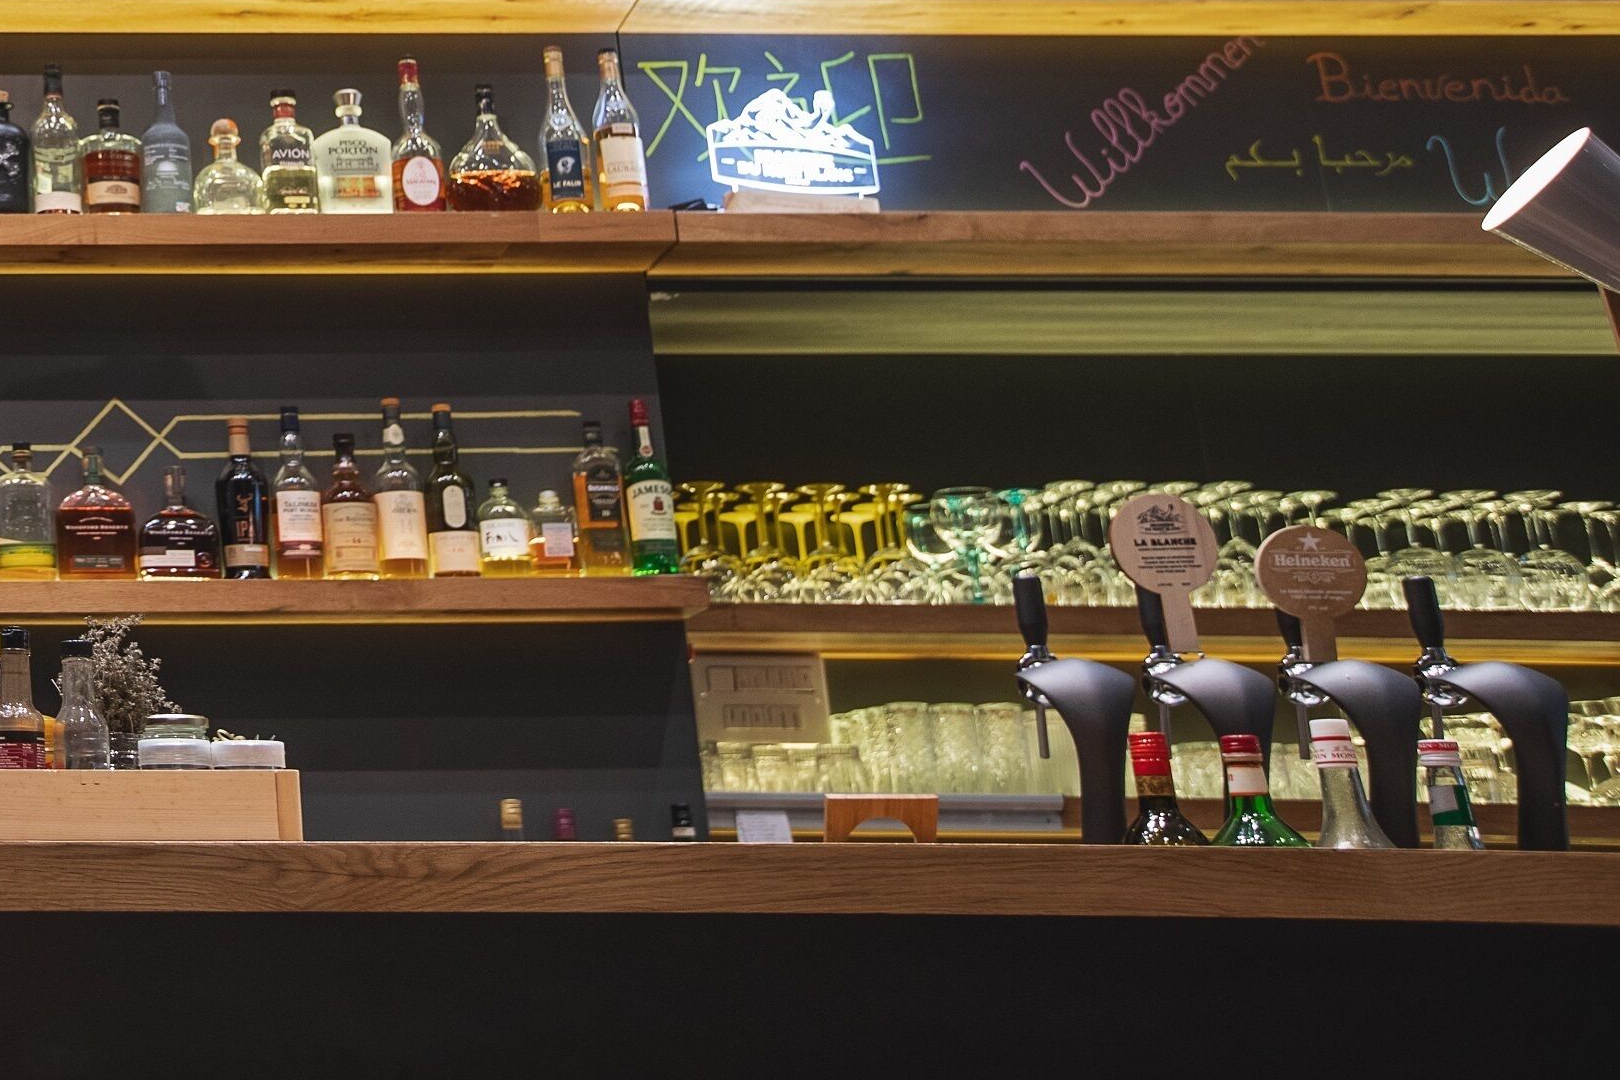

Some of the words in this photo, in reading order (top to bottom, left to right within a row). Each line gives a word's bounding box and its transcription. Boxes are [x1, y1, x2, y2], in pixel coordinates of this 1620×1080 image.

[1306, 51, 1572, 105] Bienvenida
[1019, 36, 1268, 209] Willkommen
[1133, 539, 1148, 547] LA
[1150, 537, 1197, 546] BLANCHE
[1274, 554, 1350, 567] Heineken
